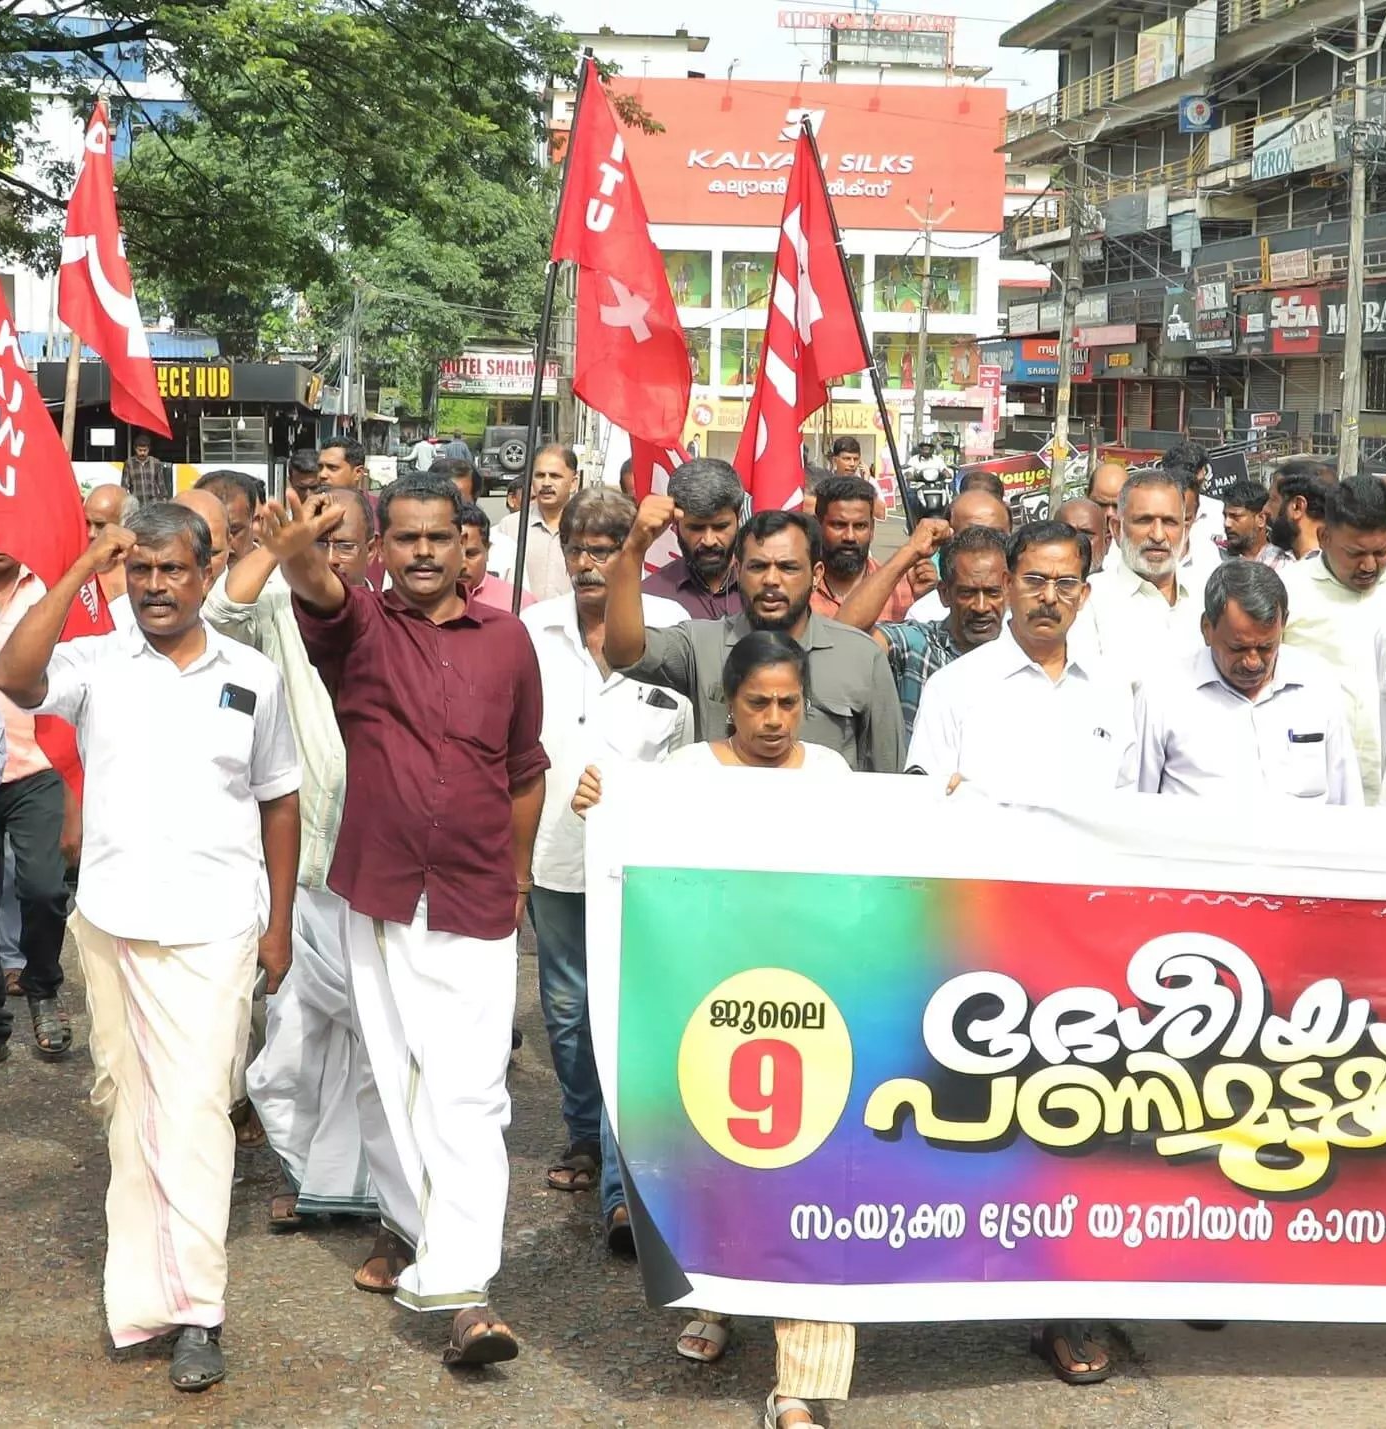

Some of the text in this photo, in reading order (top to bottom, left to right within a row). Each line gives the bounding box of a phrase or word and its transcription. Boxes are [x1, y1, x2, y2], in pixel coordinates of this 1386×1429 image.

[838, 153, 915, 174] SILKS
[1253, 147, 1292, 179] XEROX
[195, 367, 230, 397] HUB
[710, 998, 826, 1034] ജൂലൈ
[727, 1038, 803, 1150] 9
[790, 1202, 966, 1249] സംയുക്ത
[979, 1194, 1079, 1249] ട്രേഡ്
[1087, 1196, 1273, 1249] യൂണിയൻ
